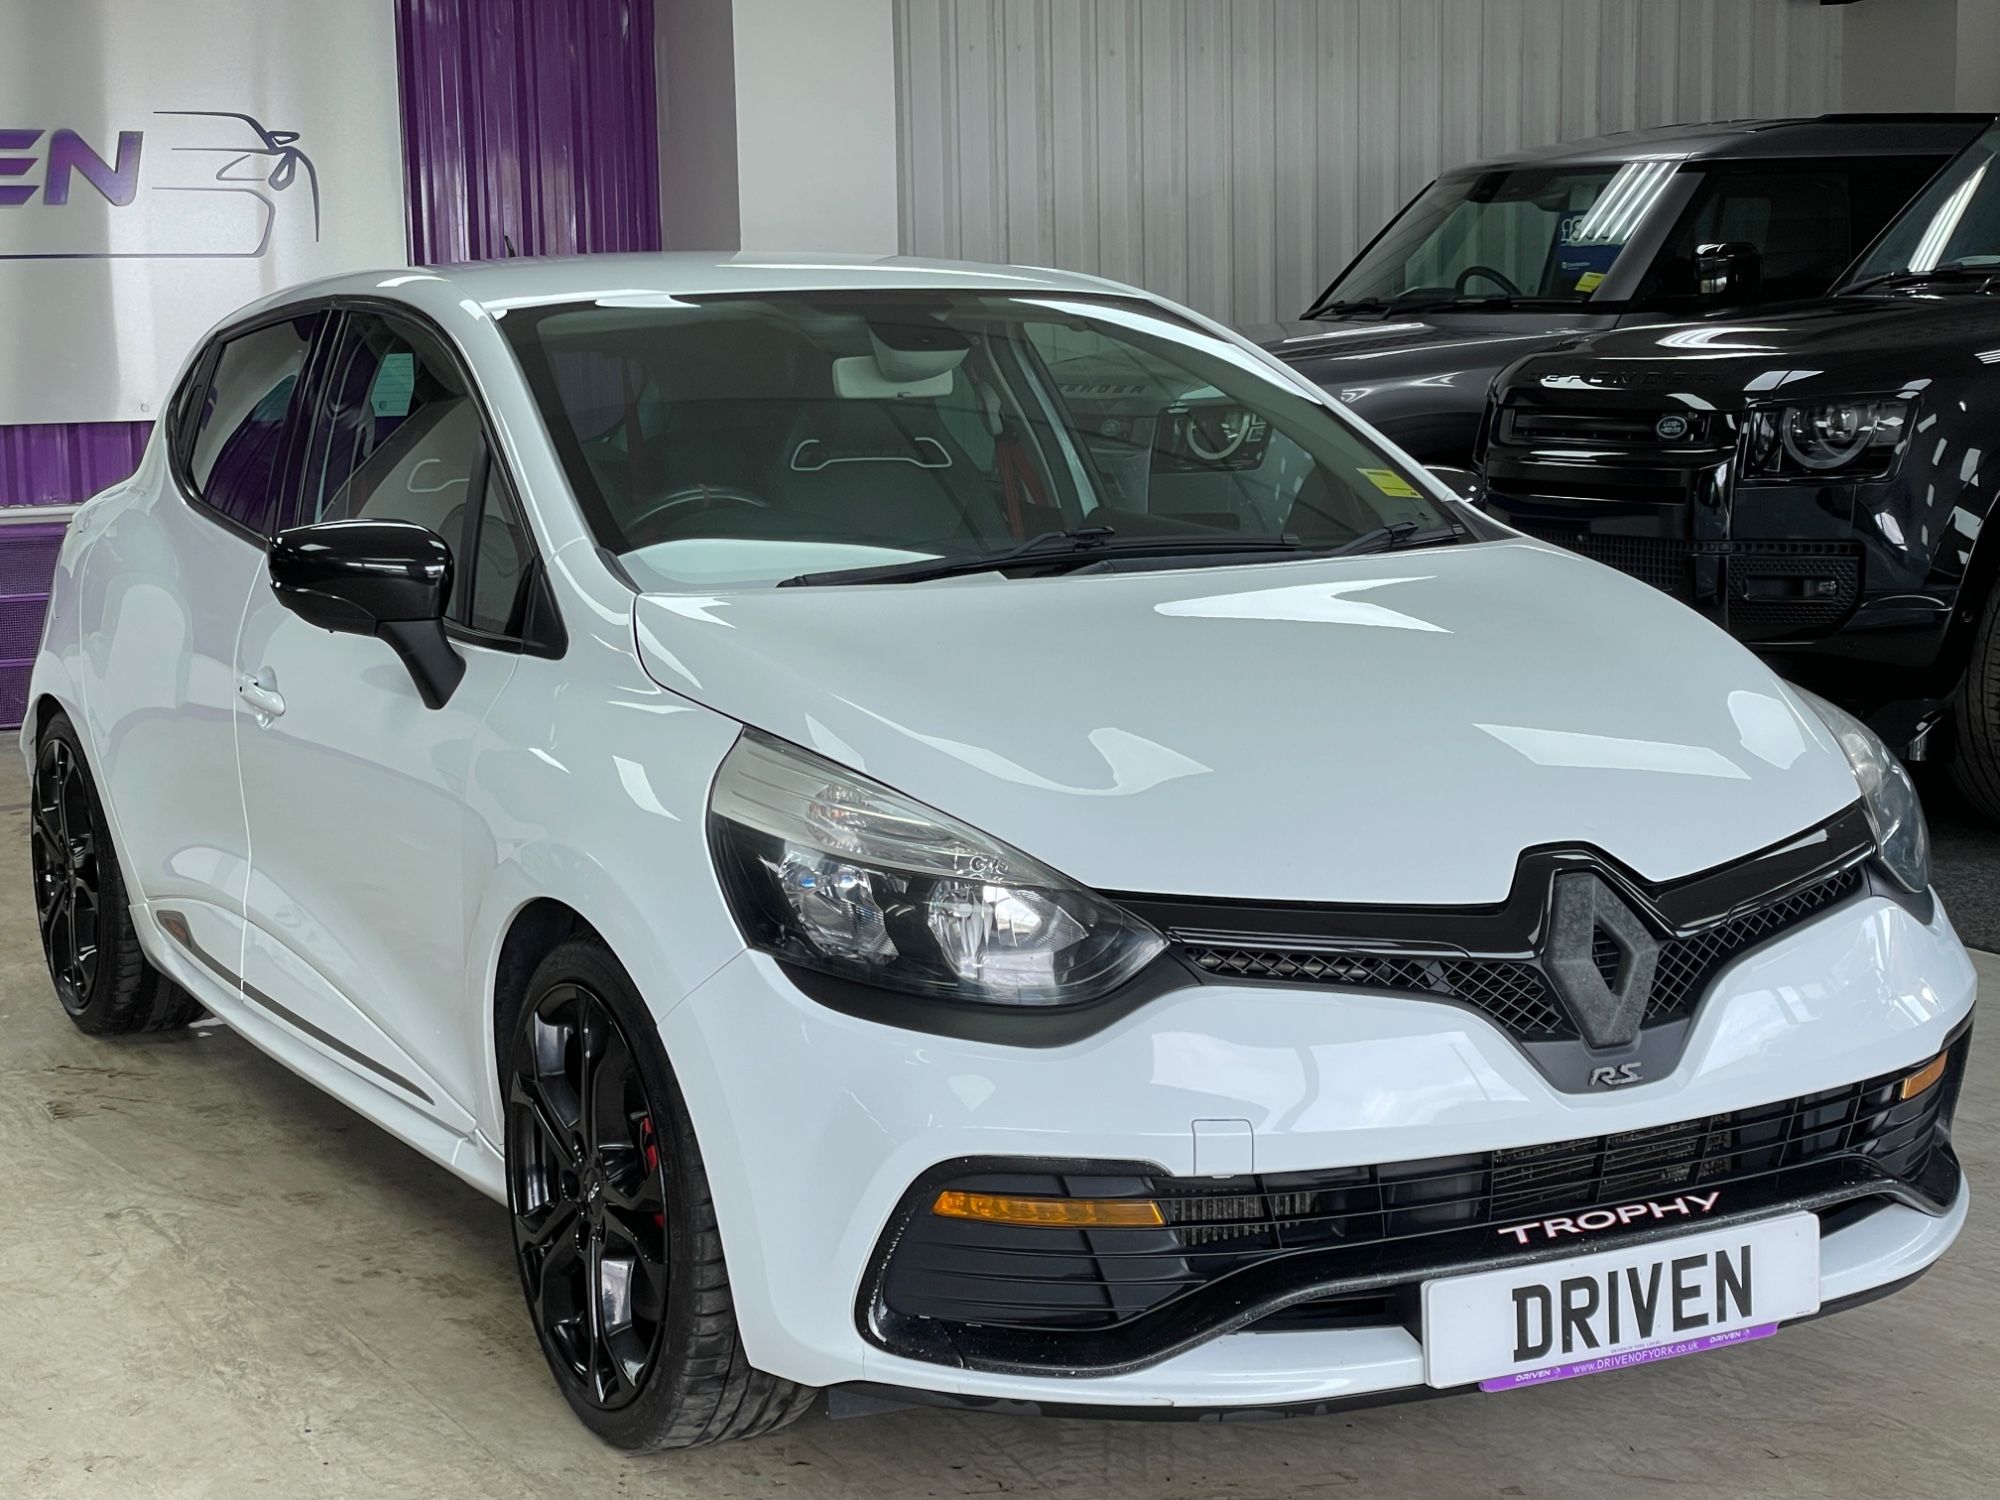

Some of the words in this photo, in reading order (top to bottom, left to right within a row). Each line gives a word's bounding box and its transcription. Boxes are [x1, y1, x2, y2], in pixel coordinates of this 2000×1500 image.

[1590, 1062, 1643, 1086] RS
[1497, 1191, 1721, 1245] TROPHY
[1512, 1244, 1753, 1363] DRIVEN
[1515, 1369, 1551, 1382] DRIVEN
[1572, 1340, 1699, 1375] www.DRIVENOFYORK.co.uk
[1709, 1331, 1741, 1344] DRIVEN
